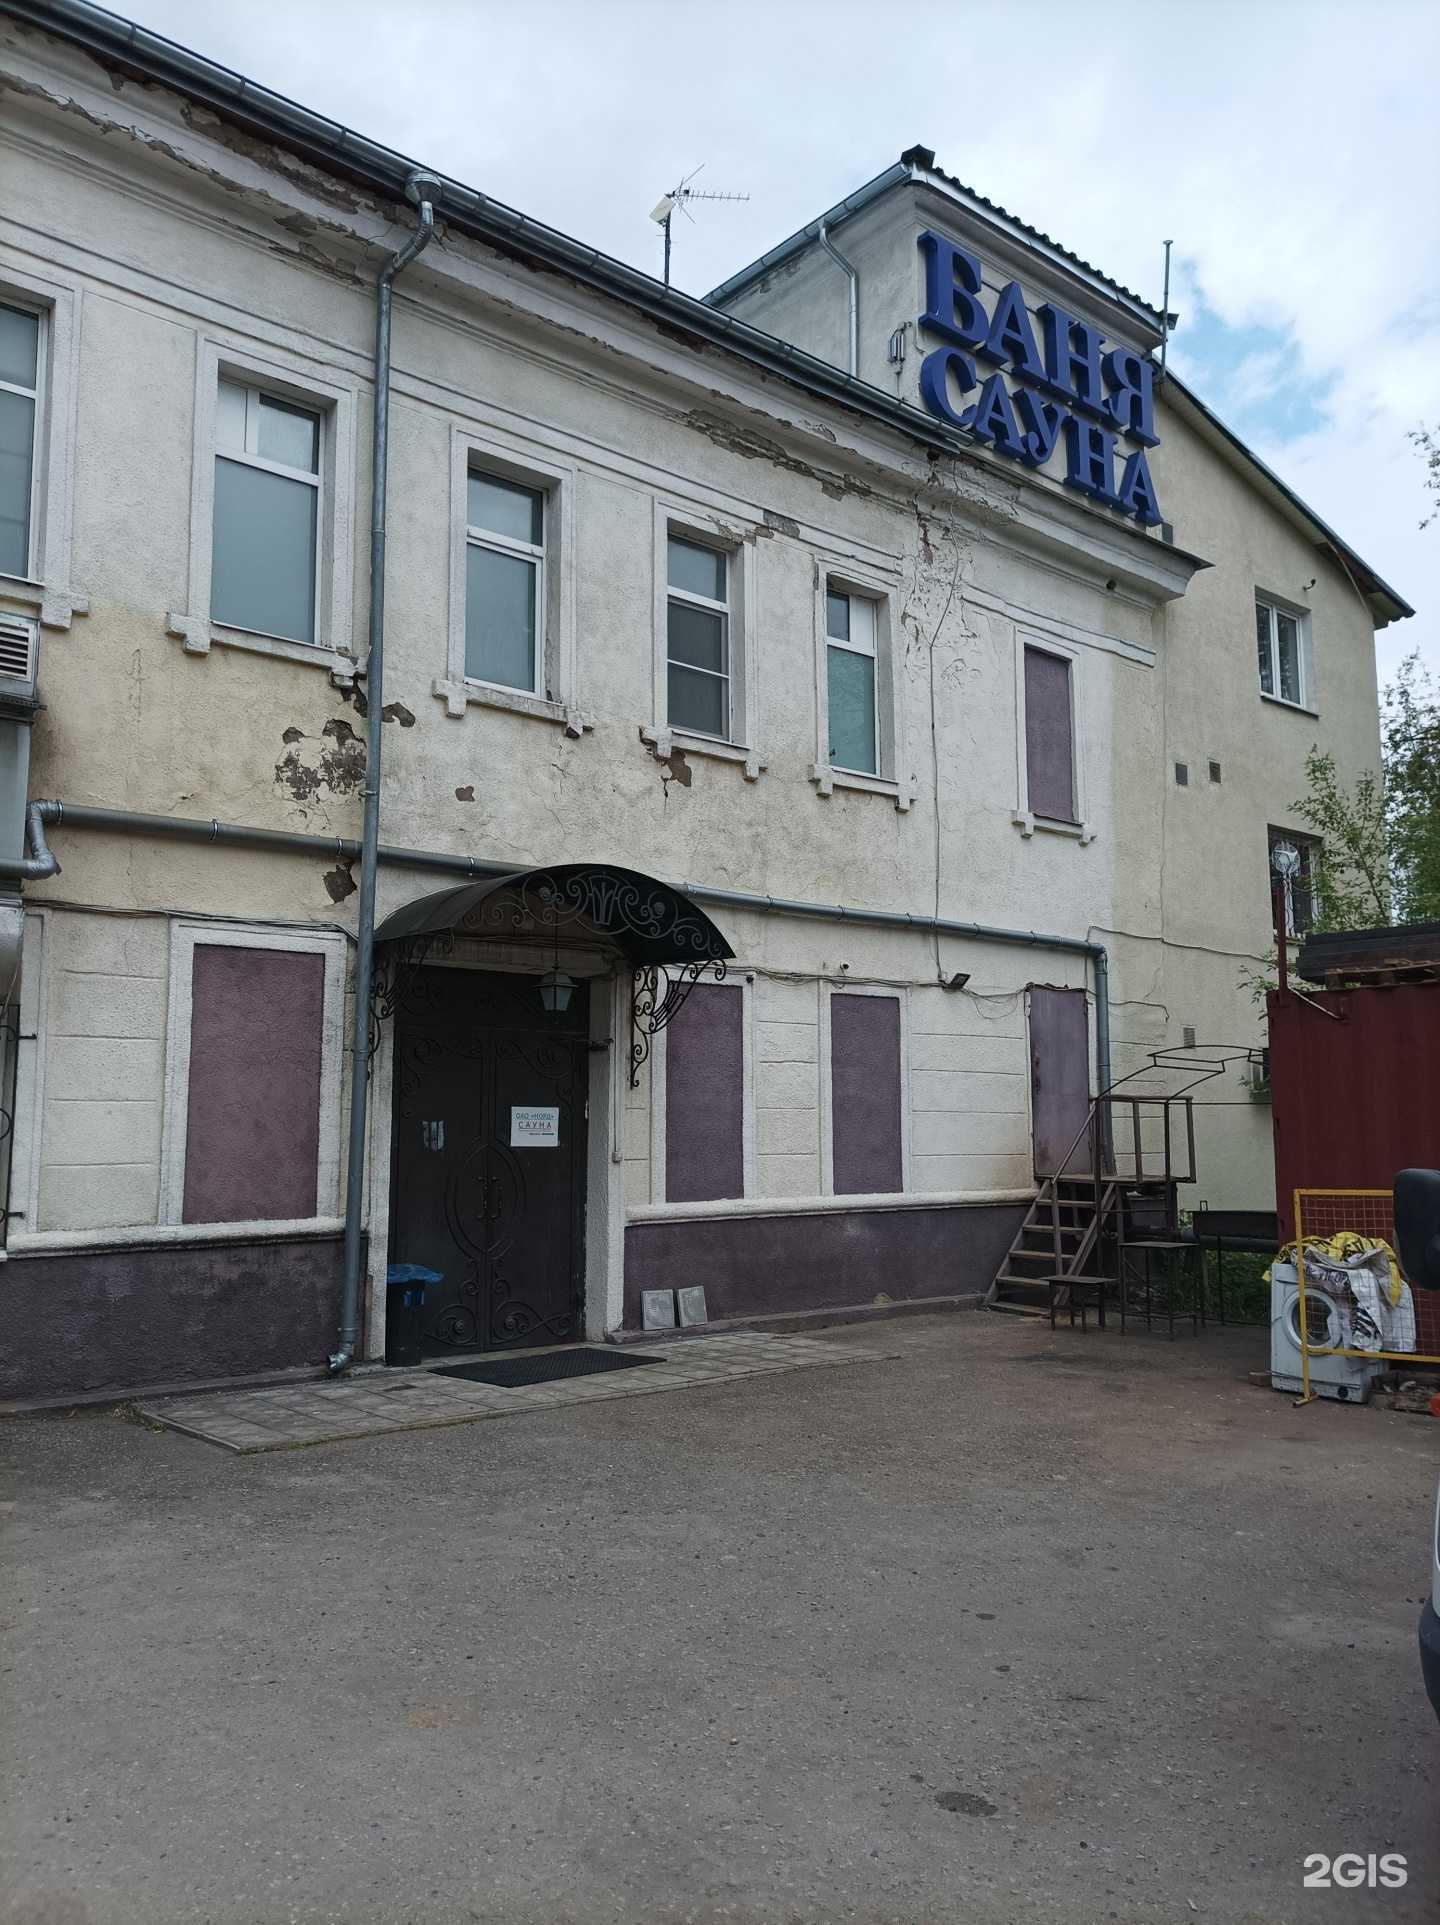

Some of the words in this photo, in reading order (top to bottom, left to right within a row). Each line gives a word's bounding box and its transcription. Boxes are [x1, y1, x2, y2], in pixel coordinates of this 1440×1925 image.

[917, 229, 1160, 448] БАНЯ
[919, 345, 1162, 527] САУНА
[518, 1121, 552, 1129] САУНА
